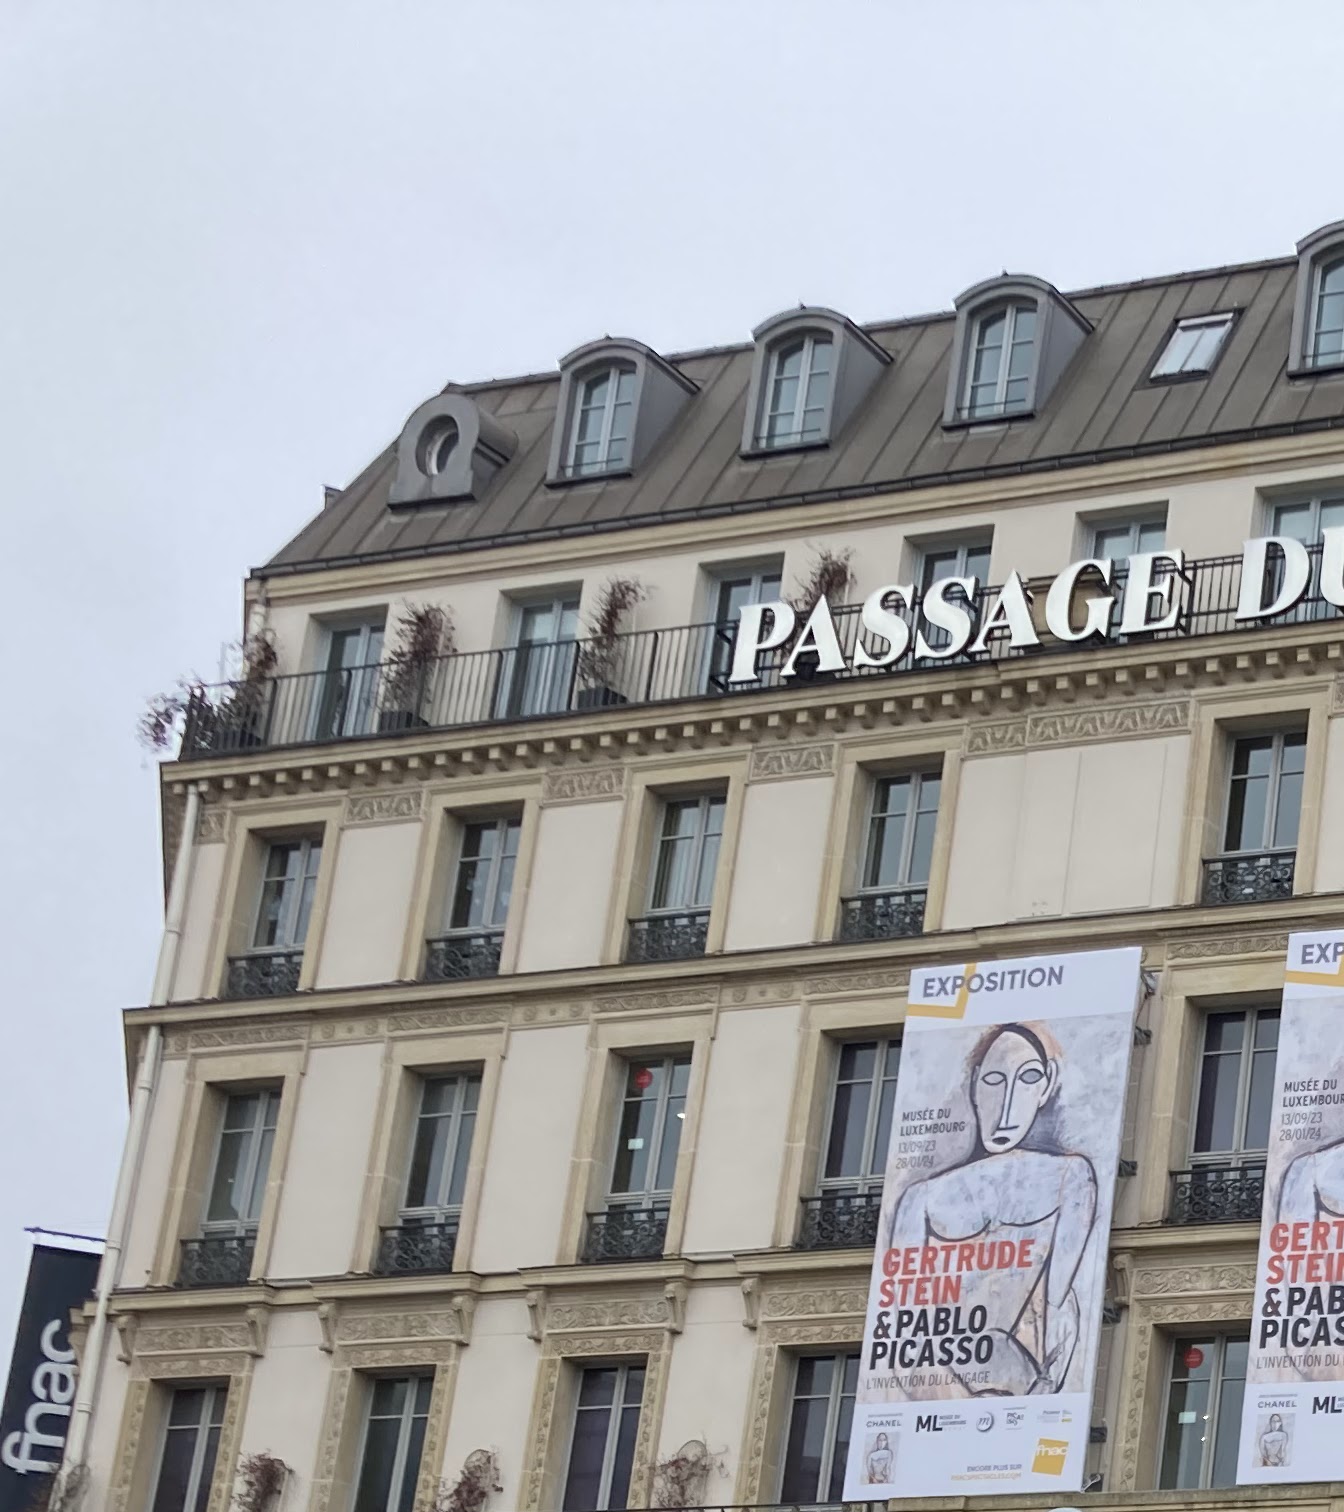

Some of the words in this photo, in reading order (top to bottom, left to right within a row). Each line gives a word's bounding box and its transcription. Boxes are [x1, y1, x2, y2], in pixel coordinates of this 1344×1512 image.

[728, 548, 1185, 683] PASSAGE
[923, 965, 1064, 998] EXPOSITION
[1284, 1079, 1320, 1093] MUSÉE
[1322, 1079, 1337, 1091] DU
[902, 1108, 935, 1122] MUSÉE
[937, 1108, 951, 1119] DU
[1280, 1111, 1323, 1126] 13/09/23
[900, 1121, 966, 1136] LUXEMBOURG
[1279, 1127, 1321, 1142] 28/01/24
[898, 1139, 936, 1153] 13/09/23
[895, 1155, 934, 1169] 28/01/24
[882, 1239, 1037, 1277] GERTRUDE
[878, 1275, 962, 1308] STEIN
[1261, 1287, 1281, 1317] &
[873, 1310, 891, 1339] &
[896, 1304, 988, 1338] PABLO
[869, 1334, 994, 1370] PICASSO
[1256, 1354, 1321, 1369] L'INVENTION
[1324, 1353, 1339, 1367] DU
[866, 1374, 926, 1390] L'INVENTION
[928, 1373, 942, 1387] DU
[944, 1371, 991, 1386] LANGAGE
[2, 1319, 79, 1474] fnac
[1257, 1399, 1298, 1408] CHANEL
[866, 1419, 902, 1428] CHANEL
